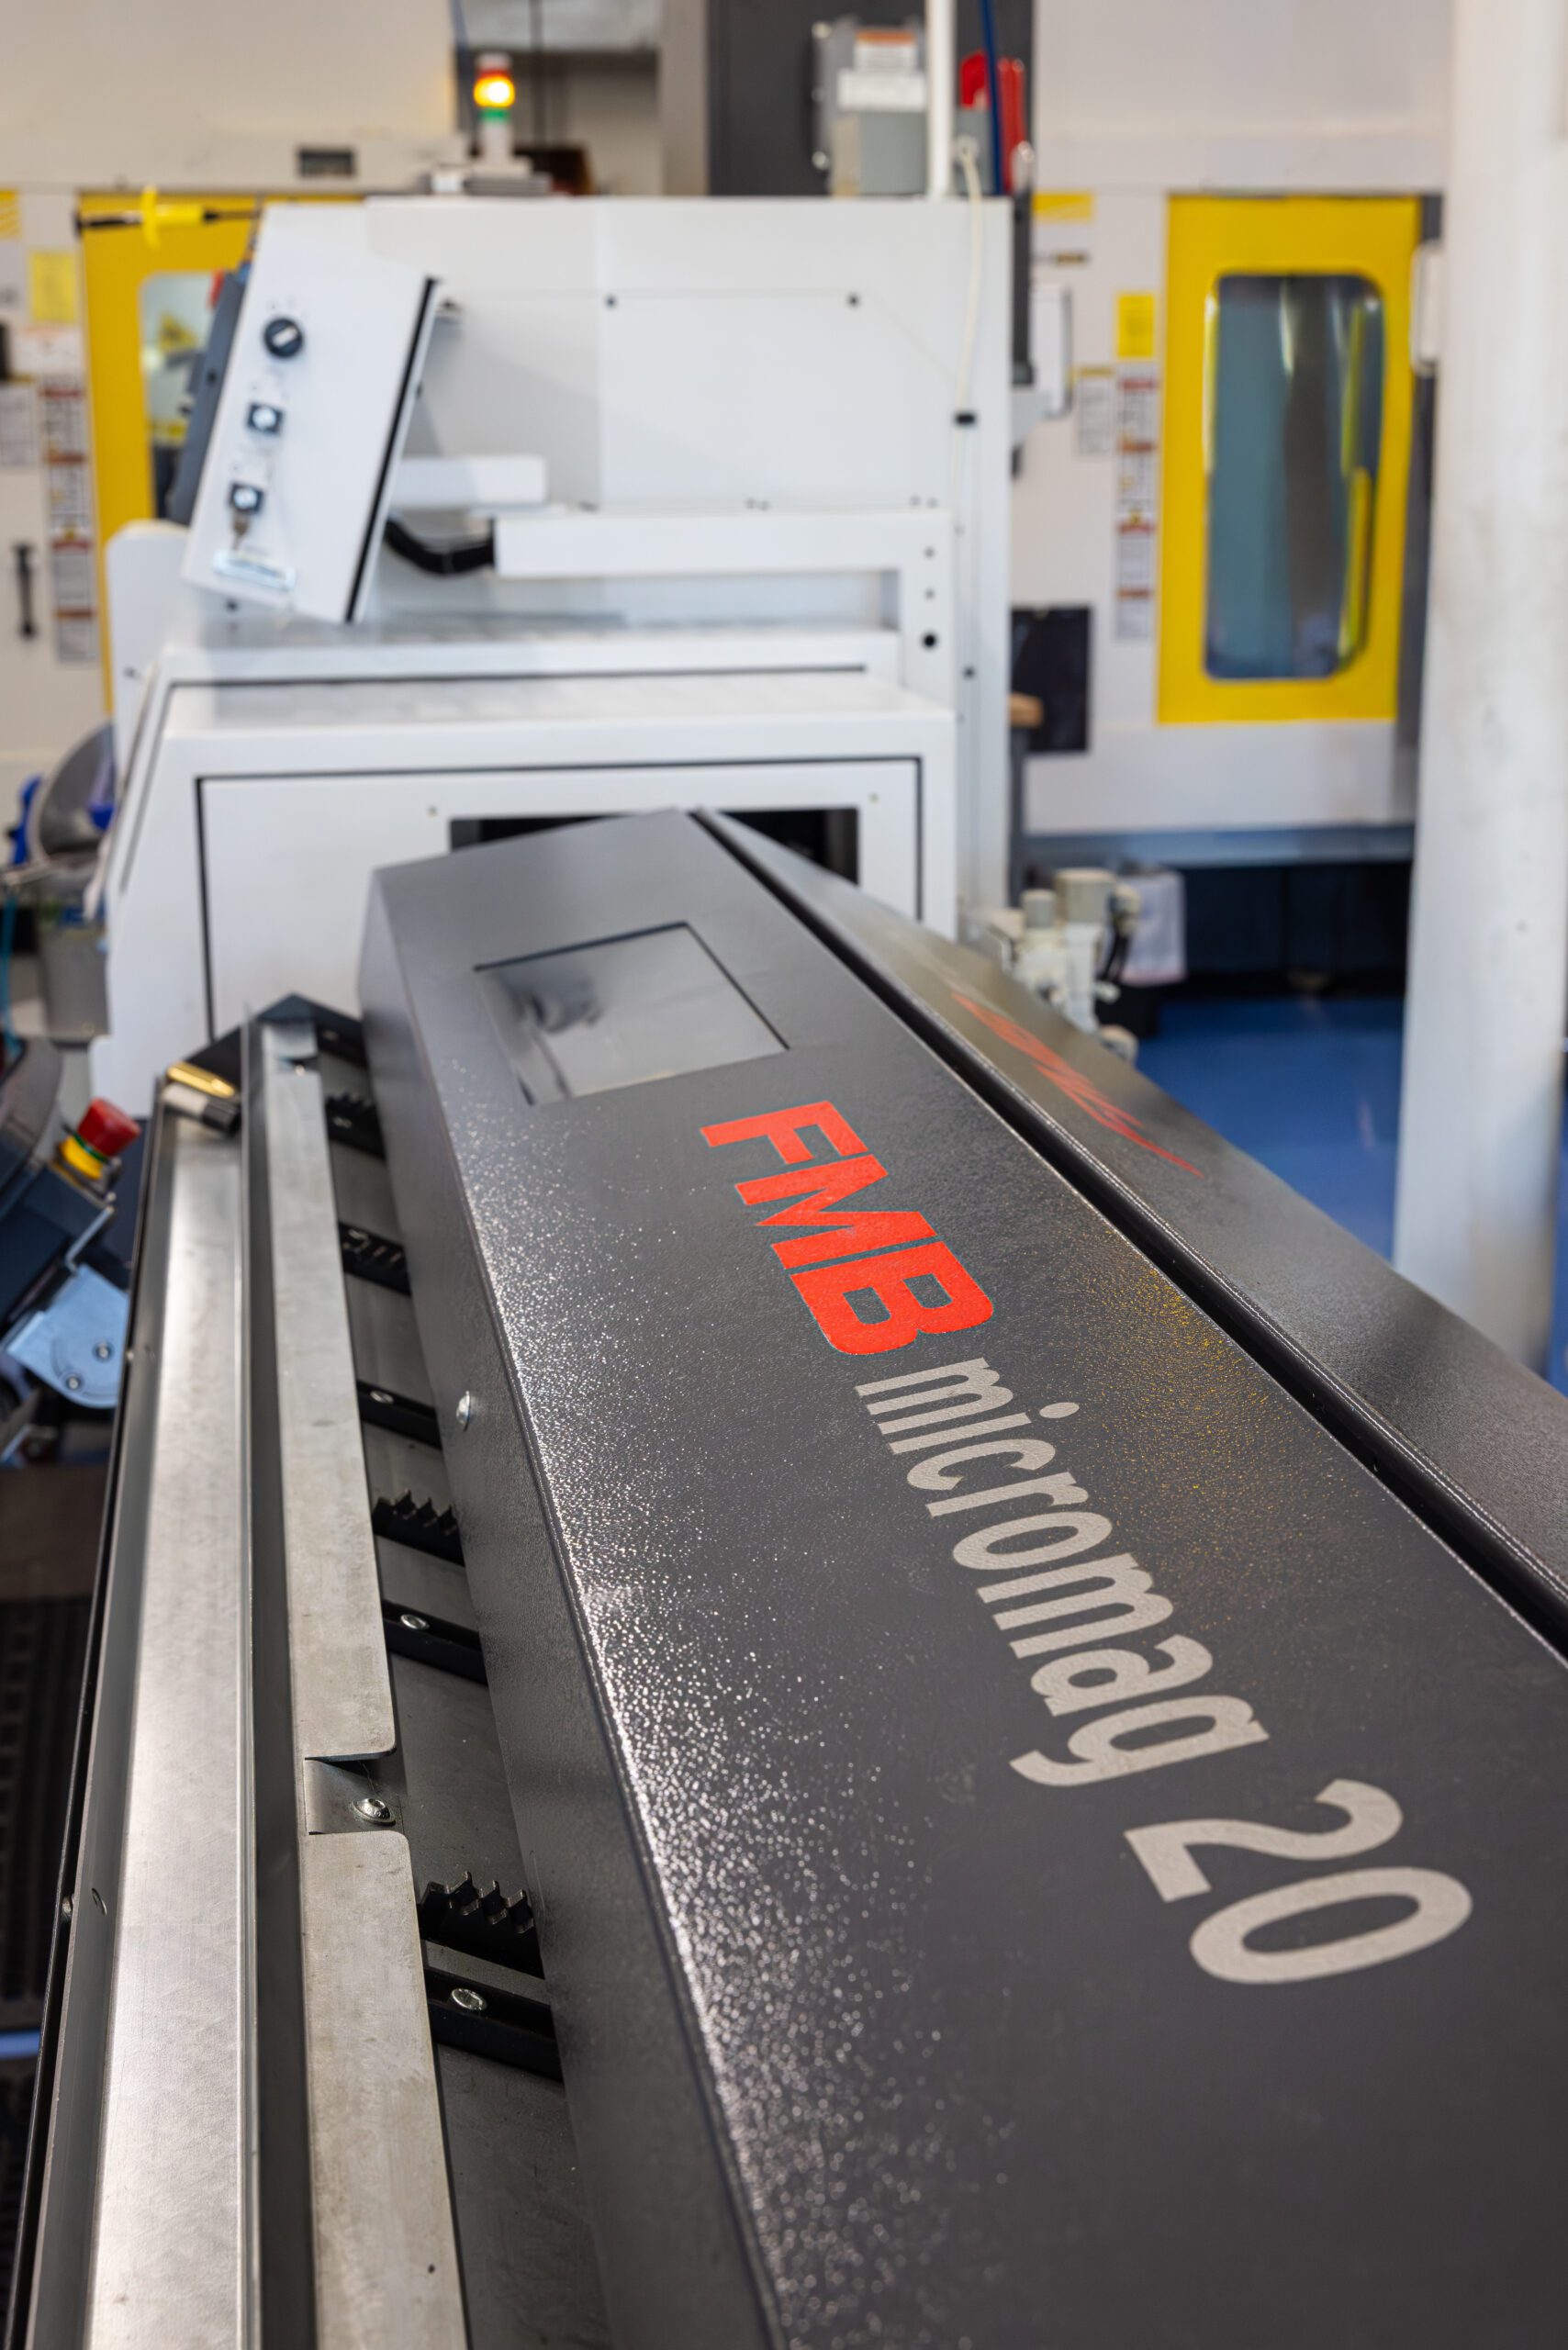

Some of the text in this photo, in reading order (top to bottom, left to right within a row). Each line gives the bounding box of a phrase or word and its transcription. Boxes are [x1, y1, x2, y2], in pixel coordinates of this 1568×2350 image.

[700, 1101, 994, 1356] FMB
[855, 1358, 1269, 1786] micromag
[1125, 1779, 1473, 1984] 20
